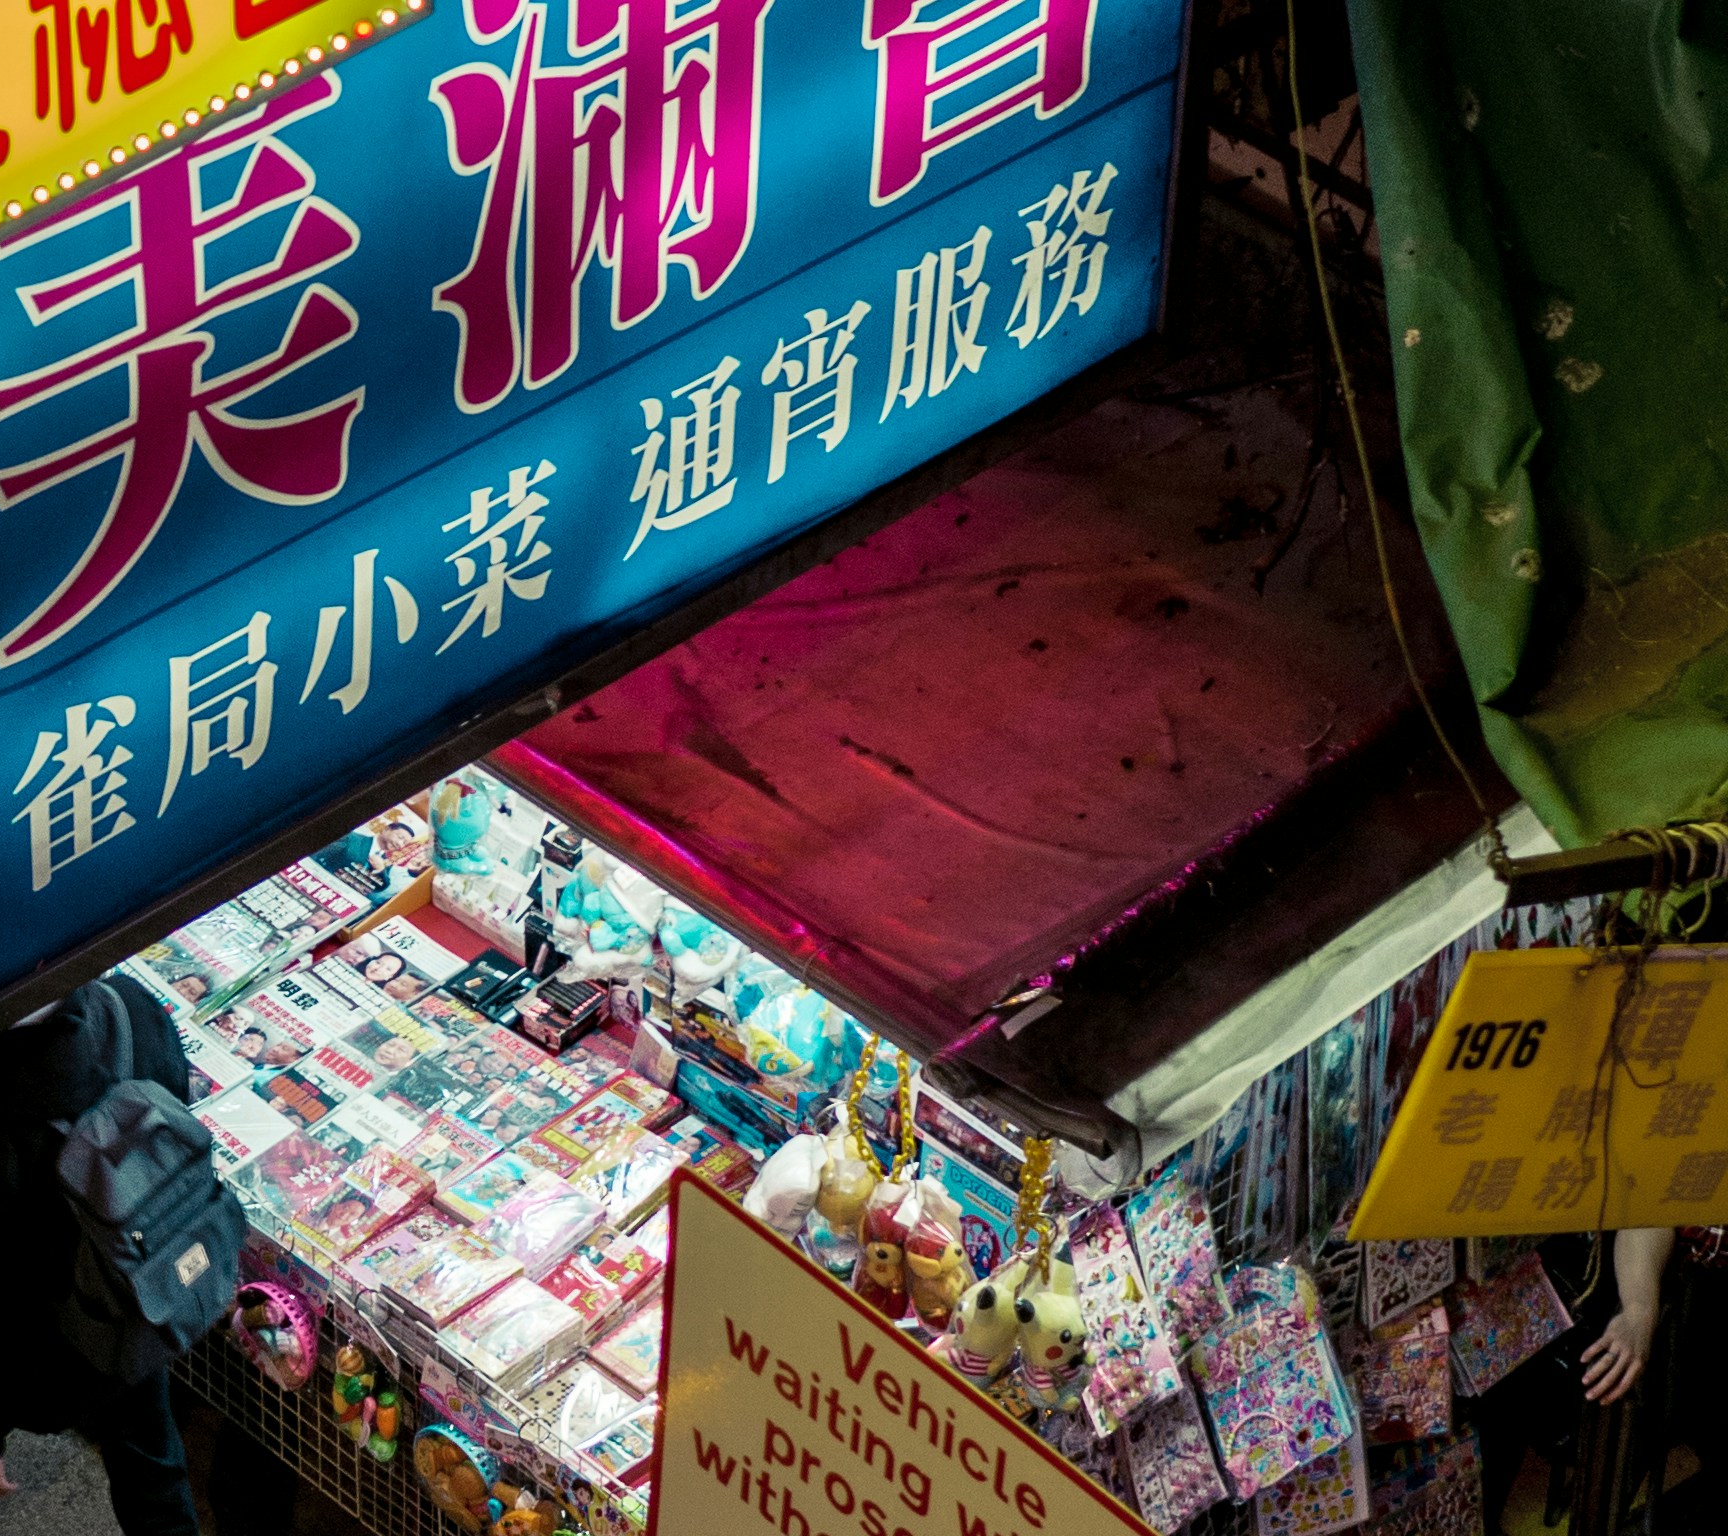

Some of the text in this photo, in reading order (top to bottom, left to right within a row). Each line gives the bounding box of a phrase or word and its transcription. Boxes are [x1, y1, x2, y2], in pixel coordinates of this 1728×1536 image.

[9, 161, 1120, 892] 雀局小菜 通宵服務
[1445, 1020, 1547, 1072] 1976
[723, 1315, 933, 1516] waiting
[837, 1321, 1047, 1528] Vehicle
